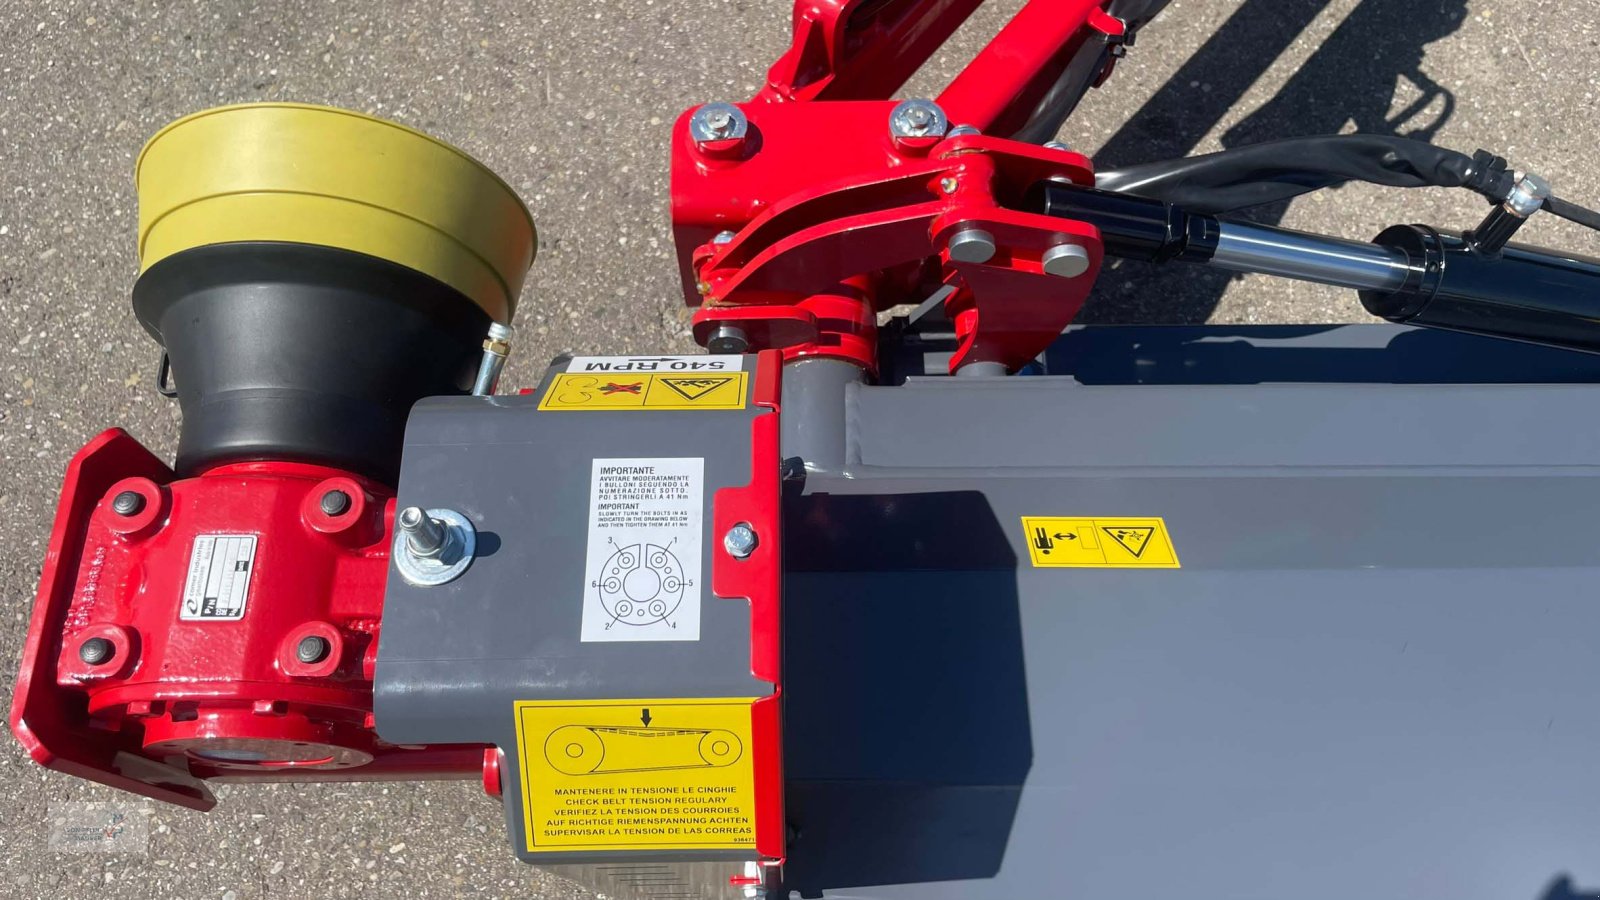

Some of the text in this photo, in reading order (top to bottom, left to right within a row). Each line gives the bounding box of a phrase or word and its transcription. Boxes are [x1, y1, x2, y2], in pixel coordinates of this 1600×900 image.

[585, 361, 726, 371] 540 RPM
[600, 467, 655, 475] IMPORTANTE
[204, 599, 216, 614] P/N
